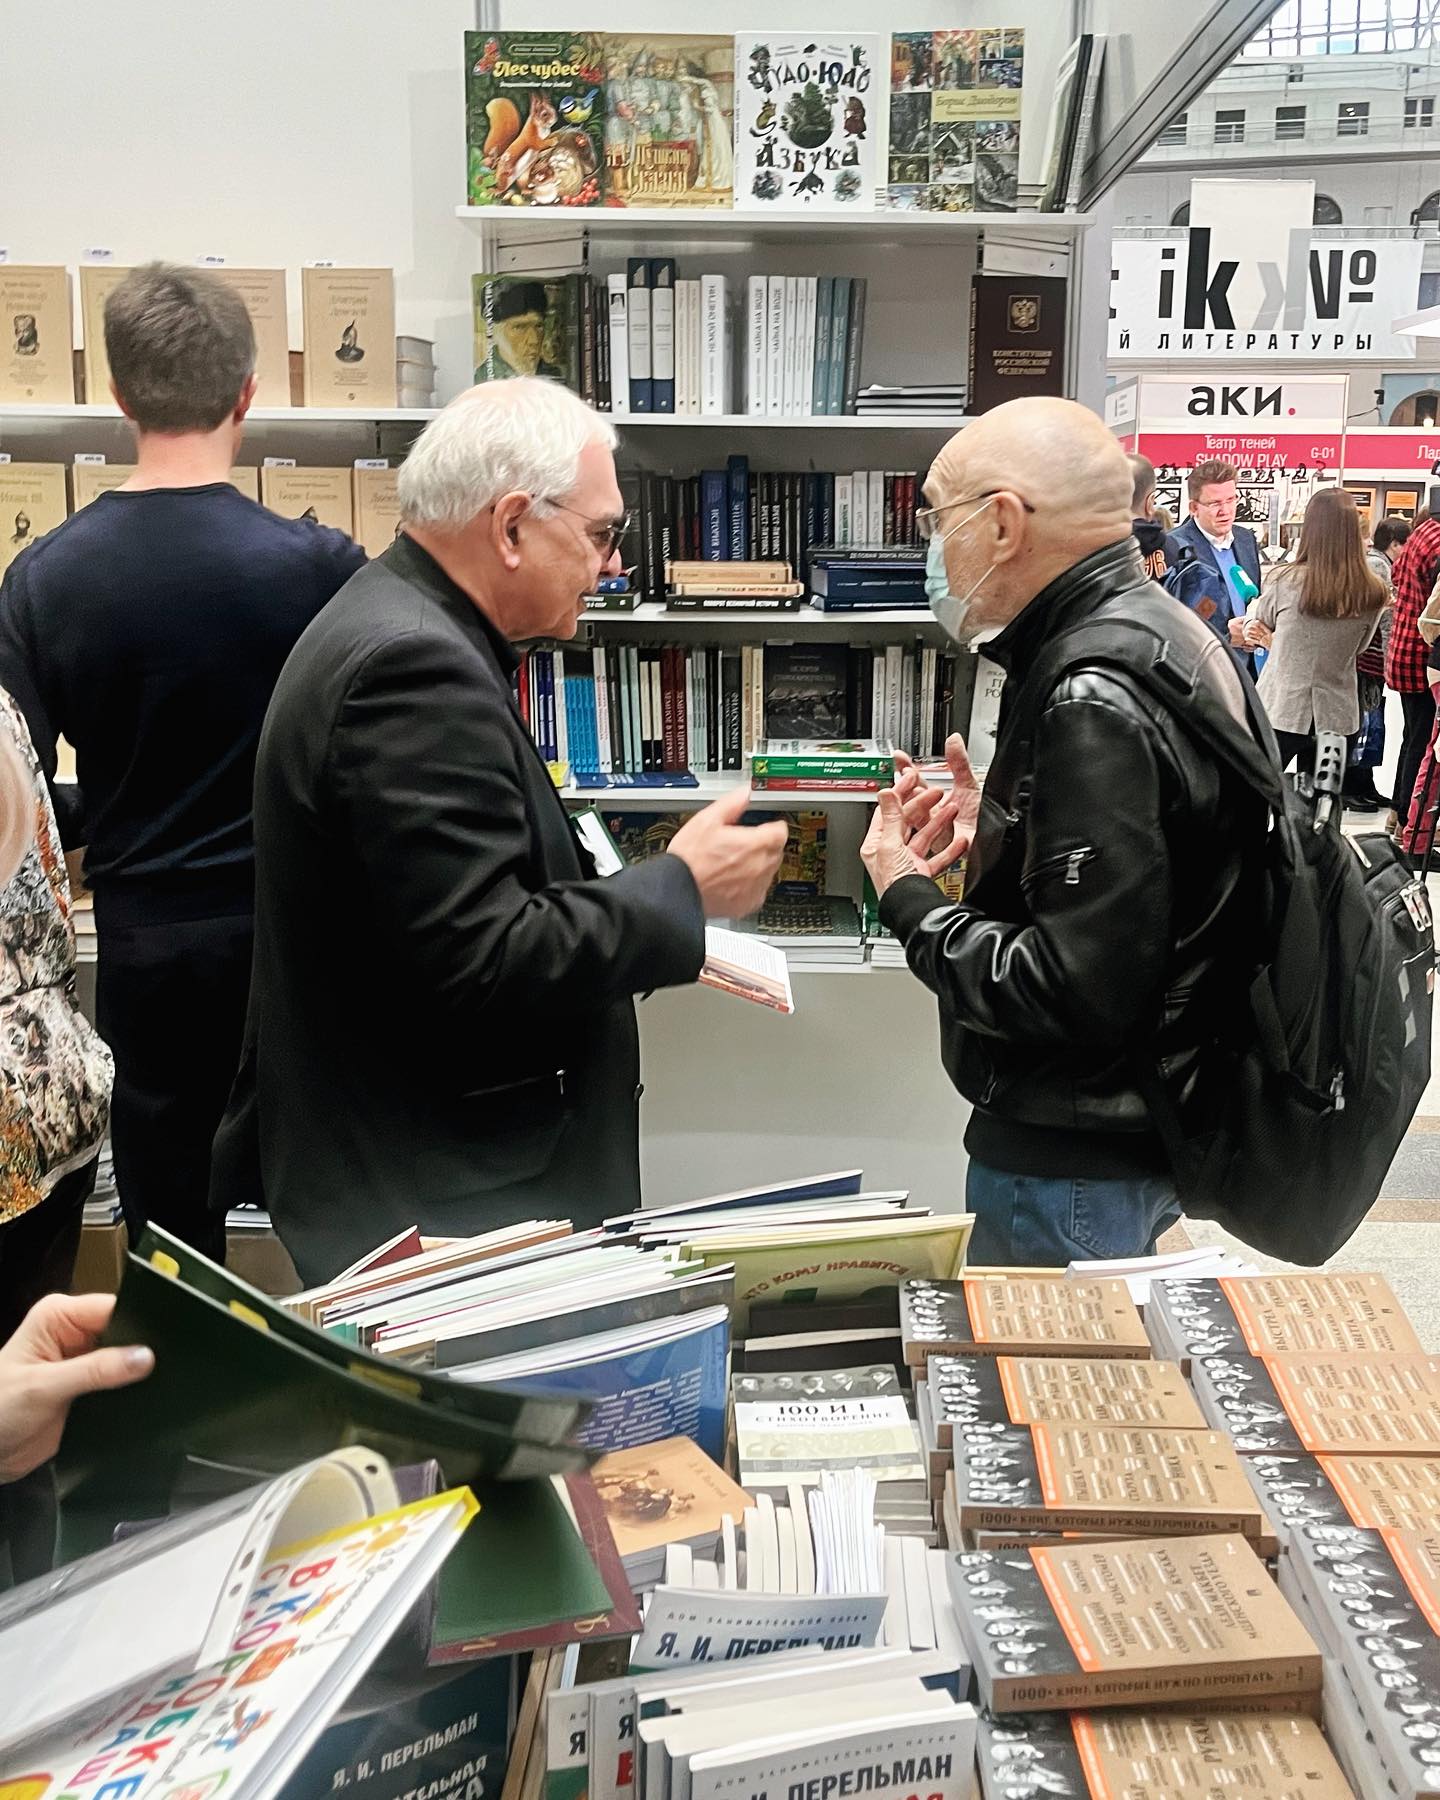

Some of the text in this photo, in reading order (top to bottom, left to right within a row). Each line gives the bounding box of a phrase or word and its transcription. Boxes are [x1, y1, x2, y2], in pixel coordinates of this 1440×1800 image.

[493, 60, 581, 80] Лес чудес
[1157, 332, 1373, 350] ЛИТЕРАТУРЫ
[1205, 435, 1276, 450] Театр теней
[1195, 453, 1288, 468] SHADOW PLAY
[1310, 447, 1335, 459] G-01
[772, 1264, 821, 1284] КОМУ
[826, 1260, 911, 1276] НРАВИТСЯ
[1108, 1518, 1148, 1528] НУЖНО
[290, 1557, 339, 1588] В
[655, 1632, 680, 1658] Я.
[690, 1635, 714, 1662] И.
[1154, 1678, 1200, 1690] НУЖНО
[1203, 1672, 1274, 1687] ПРОЧИТАТЬ
[332, 1712, 479, 1790] Я. И. ПЕРЕЛЬМАН
[787, 1753, 953, 1800] ПЕРЕЛЬМАН
